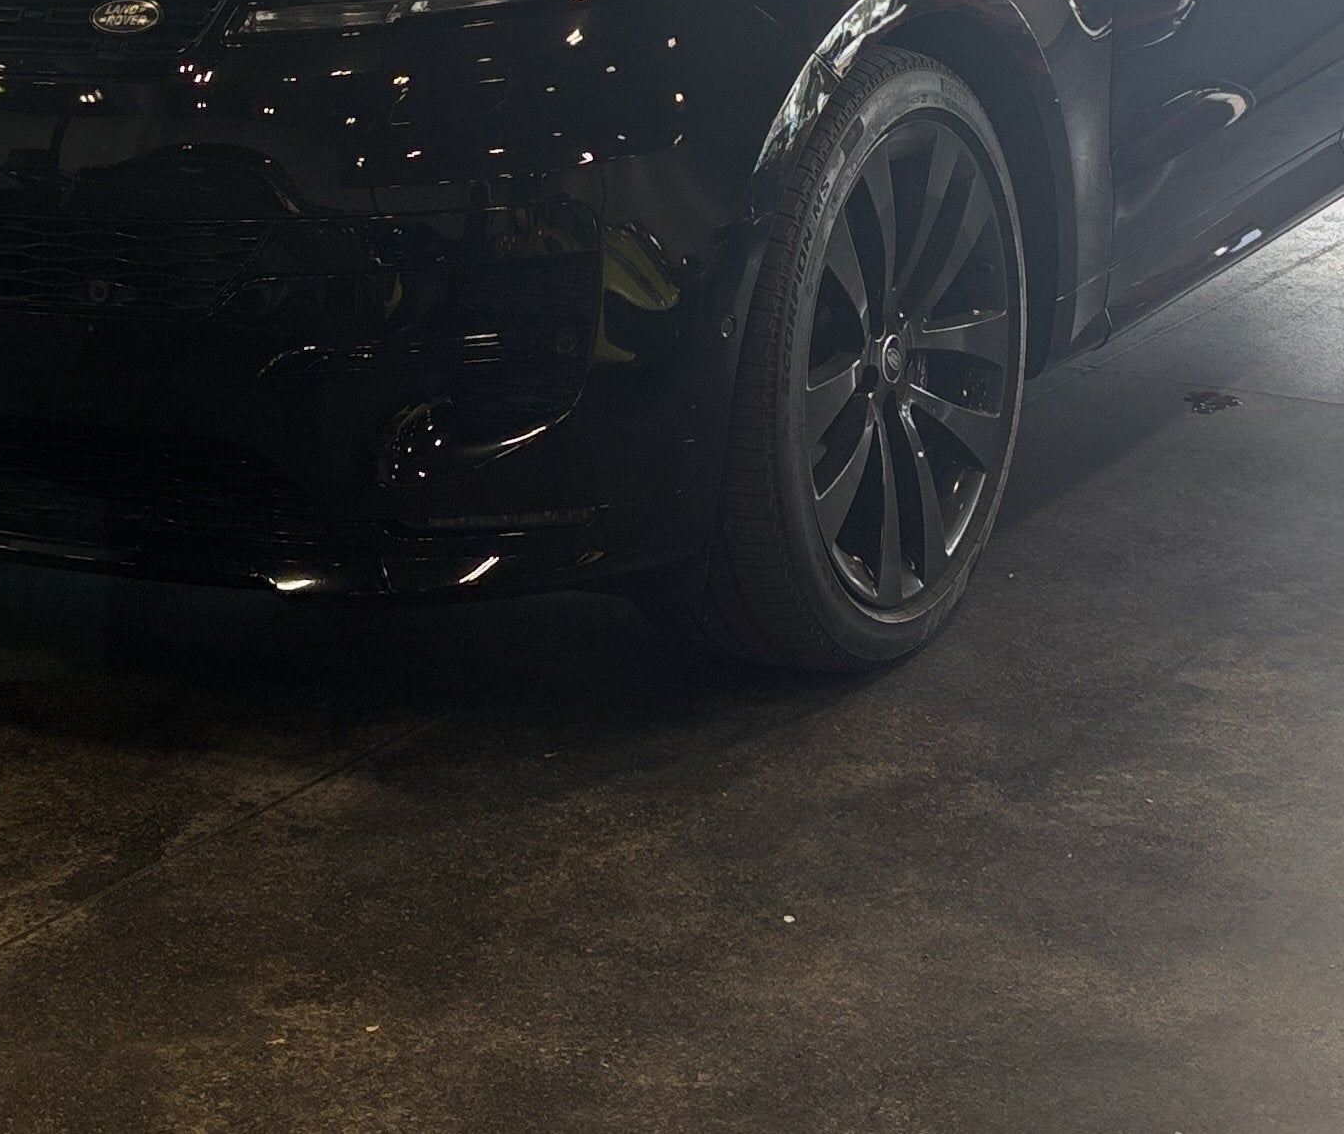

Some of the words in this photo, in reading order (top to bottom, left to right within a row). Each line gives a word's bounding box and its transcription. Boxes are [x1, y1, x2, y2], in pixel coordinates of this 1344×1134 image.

[105, 3, 140, 15] LAND
[105, 14, 148, 26] ROVER
[781, 228, 813, 397] SCORPION
